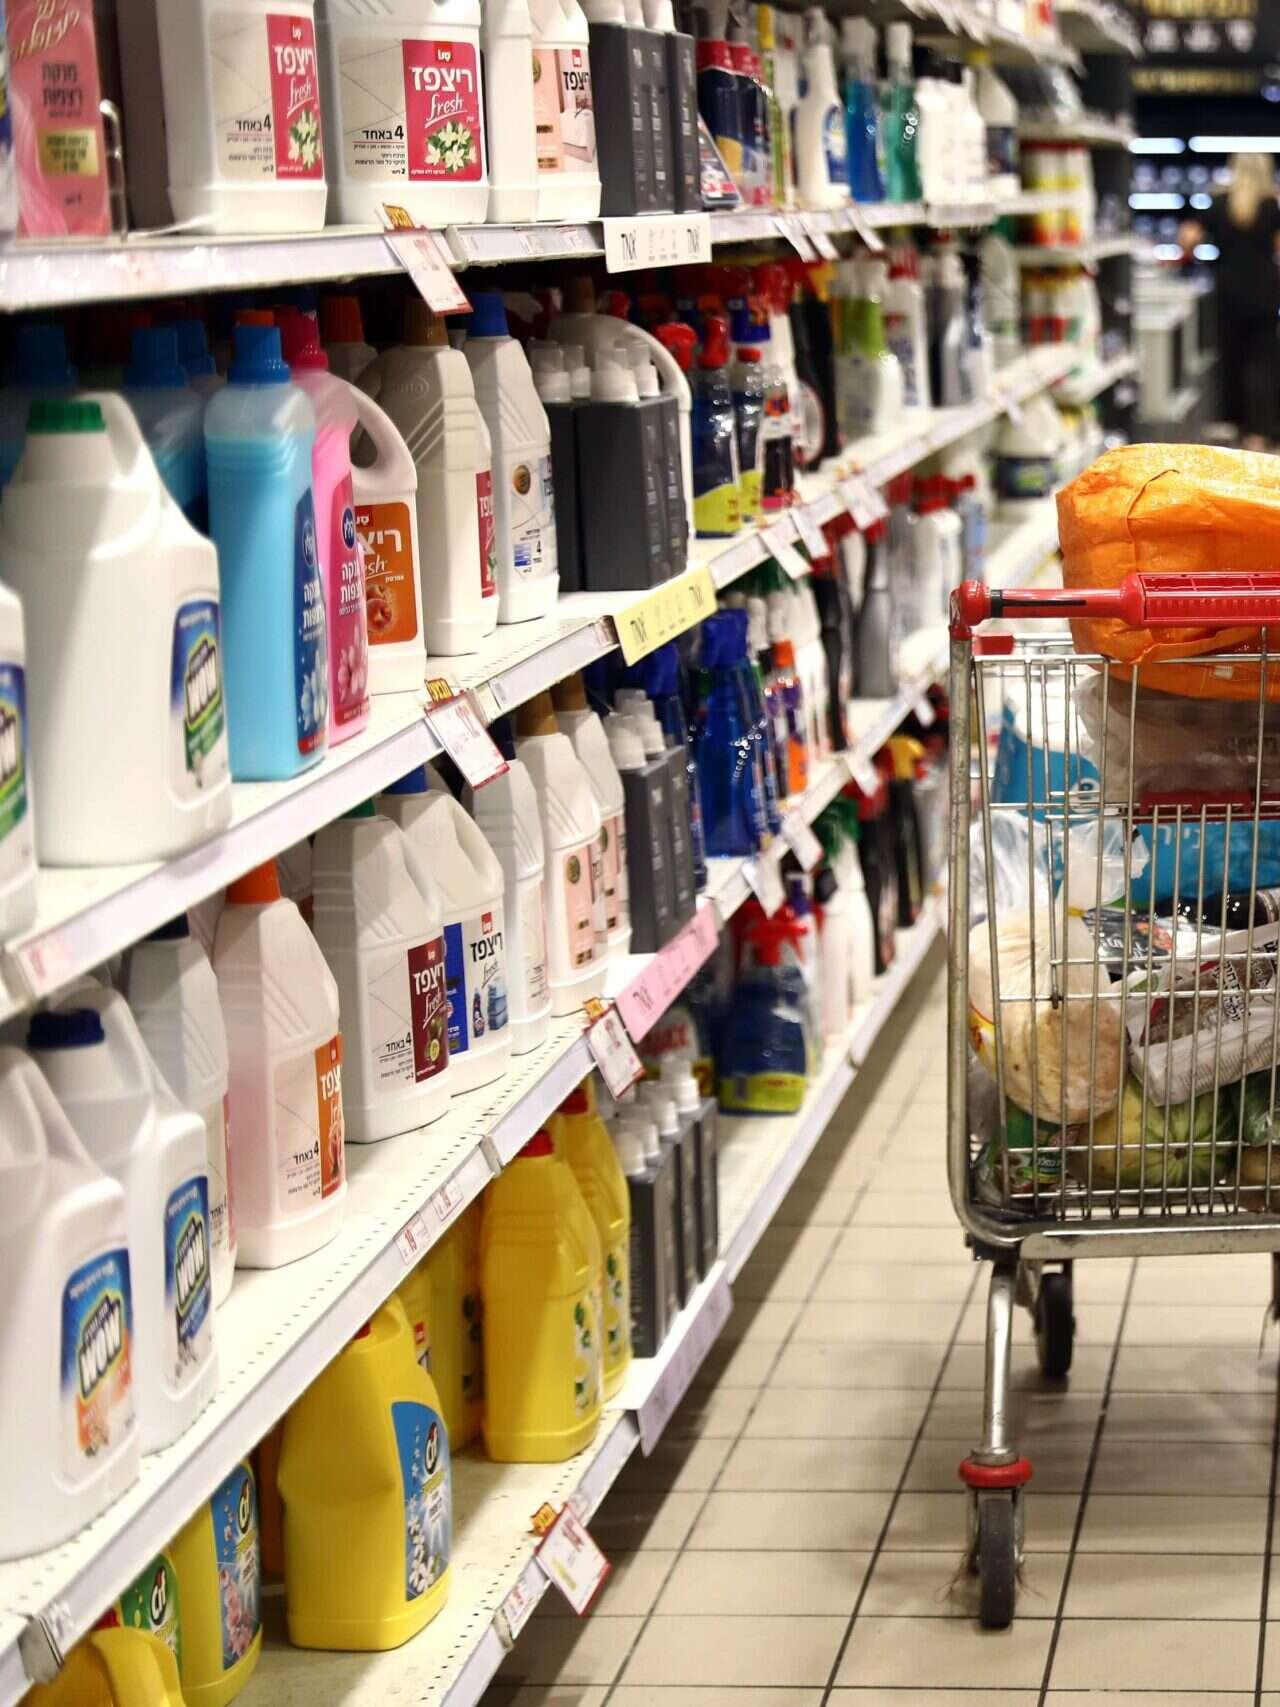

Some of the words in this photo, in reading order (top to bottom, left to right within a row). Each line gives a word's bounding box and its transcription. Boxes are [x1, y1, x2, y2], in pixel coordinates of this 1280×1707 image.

[272, 45, 316, 78] ריצפז
[437, 49, 451, 62] סנו
[411, 67, 473, 93] ריצפז
[426, 92, 464, 121] fresh
[263, 114, 272, 132] 4
[362, 129, 393, 140] באחד
[394, 125, 404, 140] 4
[357, 529, 402, 555] ריצ
[470, 932, 503, 962] ריצפז
[413, 961, 444, 995] ריצפז
[386, 1038, 405, 1053] באחד
[405, 1032, 412, 1046] 4
[320, 1064, 342, 1100] צפז
[313, 1140, 319, 1156] 4
[293, 1151, 313, 1166] באחד
